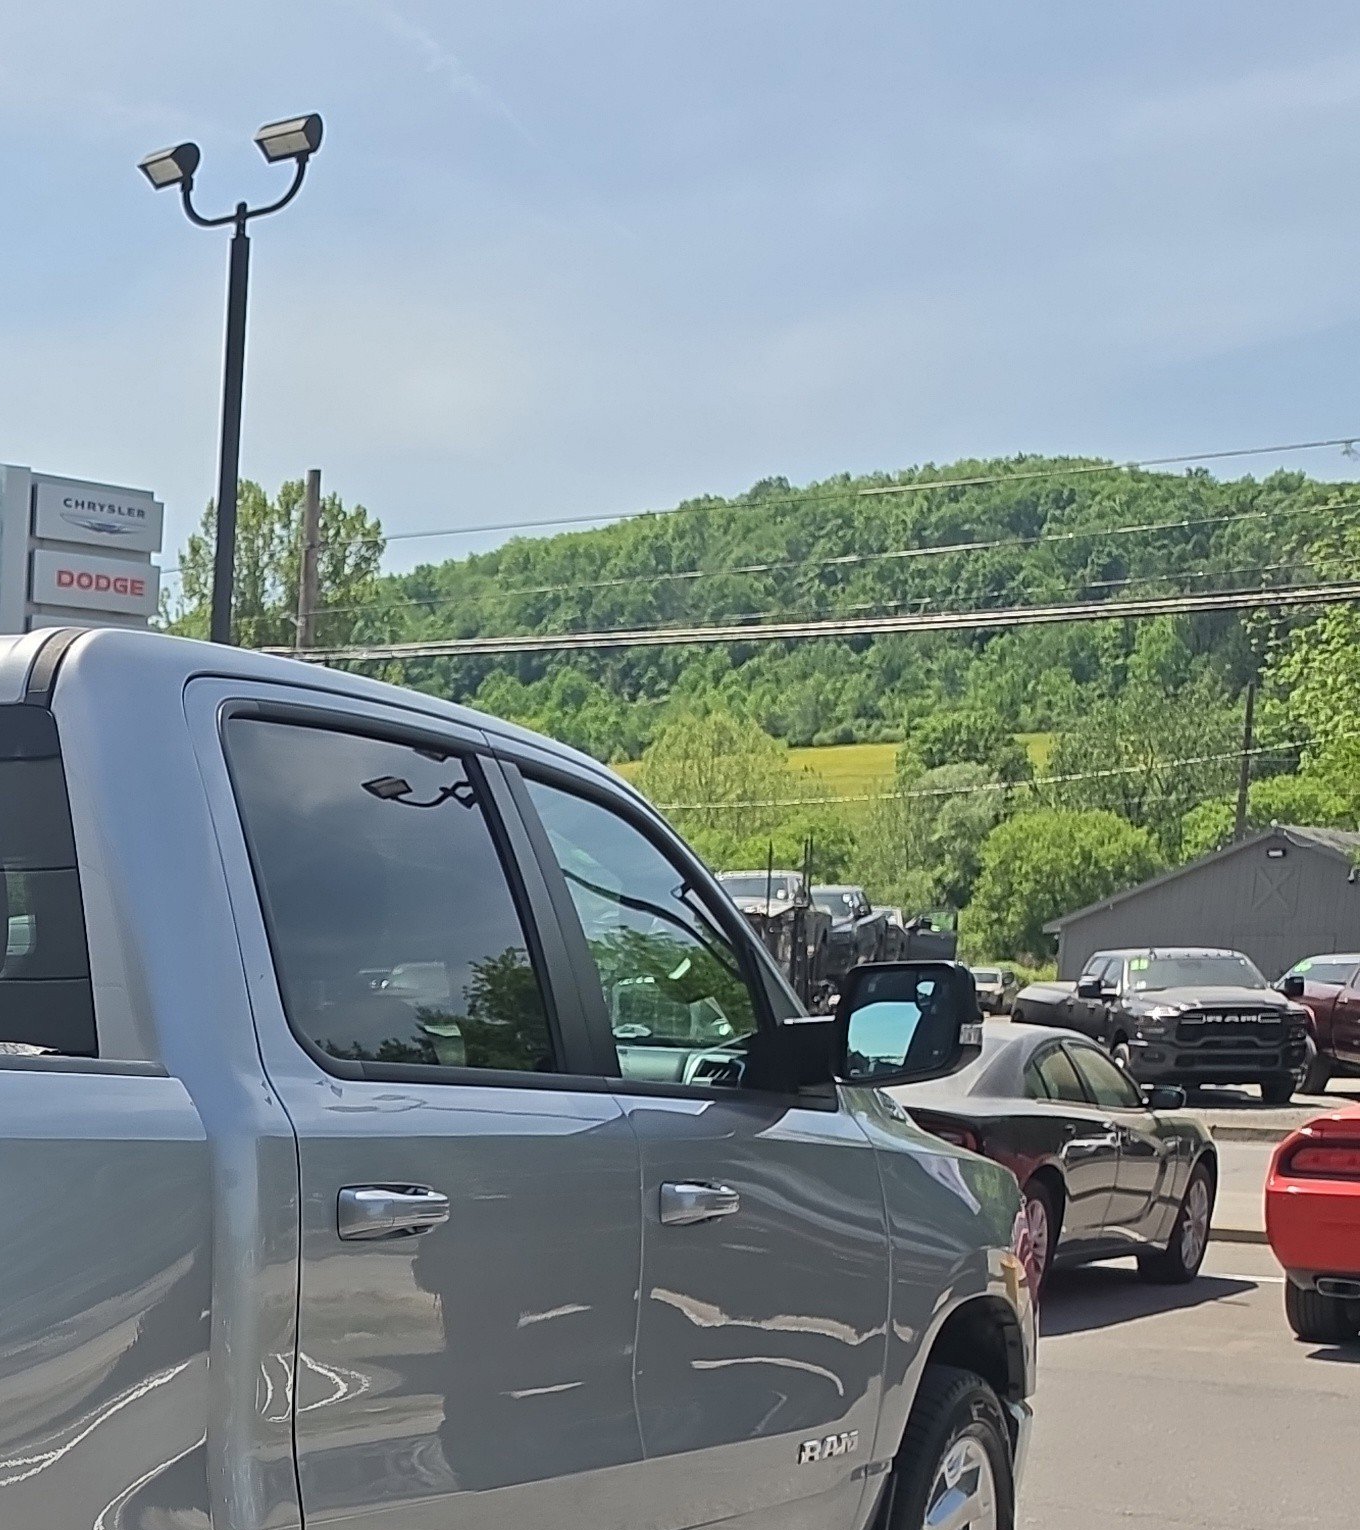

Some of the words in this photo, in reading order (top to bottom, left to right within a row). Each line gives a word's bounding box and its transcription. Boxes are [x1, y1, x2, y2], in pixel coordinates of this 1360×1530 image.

[63, 498, 146, 519] CHRYSLER
[56, 570, 145, 597] DODGE
[1207, 1015, 1257, 1023] RAM
[797, 1429, 859, 1465] RAM
